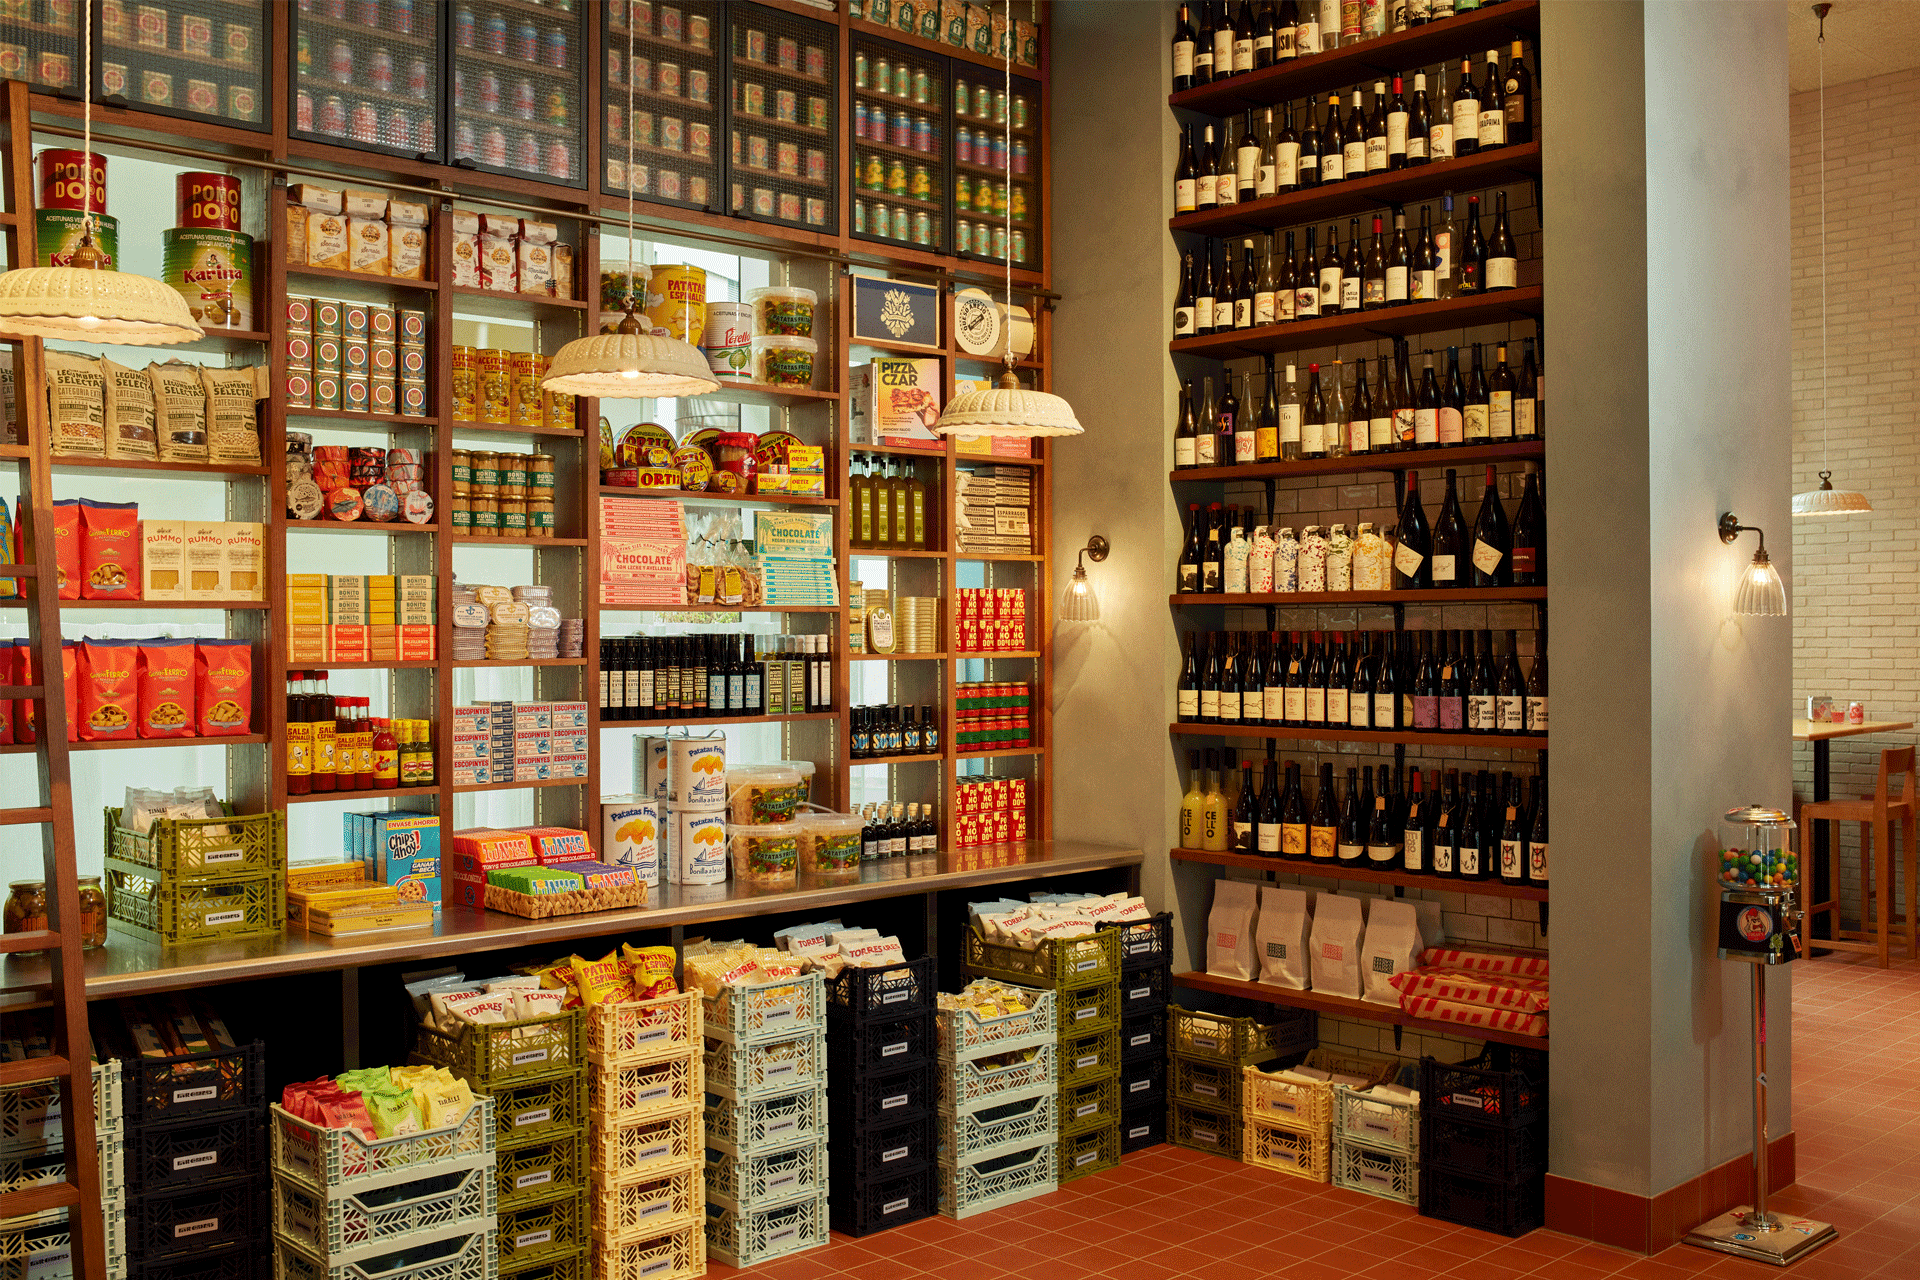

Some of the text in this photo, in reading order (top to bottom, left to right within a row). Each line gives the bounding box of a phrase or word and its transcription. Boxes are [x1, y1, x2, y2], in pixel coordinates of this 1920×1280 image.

[192, 184, 239, 205] POMO
[50, 252, 112, 267] Kaa
[183, 265, 243, 283] Karina
[668, 280, 706, 294] PATATAS
[771, 314, 797, 323] PATATAS
[771, 362, 797, 371] PATATAS
[882, 362, 918, 374] PIZZA
[882, 373, 917, 386] CZAR
[165, 386, 205, 397] SELECTAS
[631, 430, 667, 438] CONSERVAS
[625, 436, 671, 449] ORTIZ
[685, 464, 704, 474] ORTIZ
[640, 473, 680, 486] ORTIZ
[146, 534, 182, 544] RUMMO
[771, 528, 820, 539] CHOCOLATE
[187, 535, 222, 545] RUMMO
[227, 536, 261, 546] RUMMO
[616, 554, 672, 565] CHOCOLATE
[455, 707, 490, 716] ESCOPINYES
[517, 705, 550, 713] ESCOPINYES
[554, 703, 586, 712] ESCOPINYES
[454, 733, 489, 742] ESCOPINYES
[517, 730, 551, 739] ESCOPINYES
[554, 729, 587, 737] ESCOPINYES
[688, 747, 713, 757] Patatas
[454, 759, 489, 768] ESCOPINYES
[517, 756, 551, 764] ESCOPINYES
[554, 754, 587, 762] ESCOPINYES
[688, 792, 706, 803] Bonilla
[759, 801, 785, 810] PATATAS
[611, 808, 641, 821] Patatas
[388, 818, 439, 828] ENVASE AHORRO
[689, 818, 713, 828] Patatas
[388, 833, 415, 849] Chips
[756, 851, 782, 860] PATATAS
[689, 863, 708, 875] Bonilla
[1089, 903, 1117, 917] TORRES
[1119, 903, 1146, 916] TORRES
[797, 935, 825, 948] TORRES
[849, 945, 883, 958] TORRES
[724, 960, 758, 983] TORRES
[441, 991, 481, 1002] TORRES
[463, 1002, 502, 1017] TORRES
[438, 1095, 461, 1106] TARALLI
